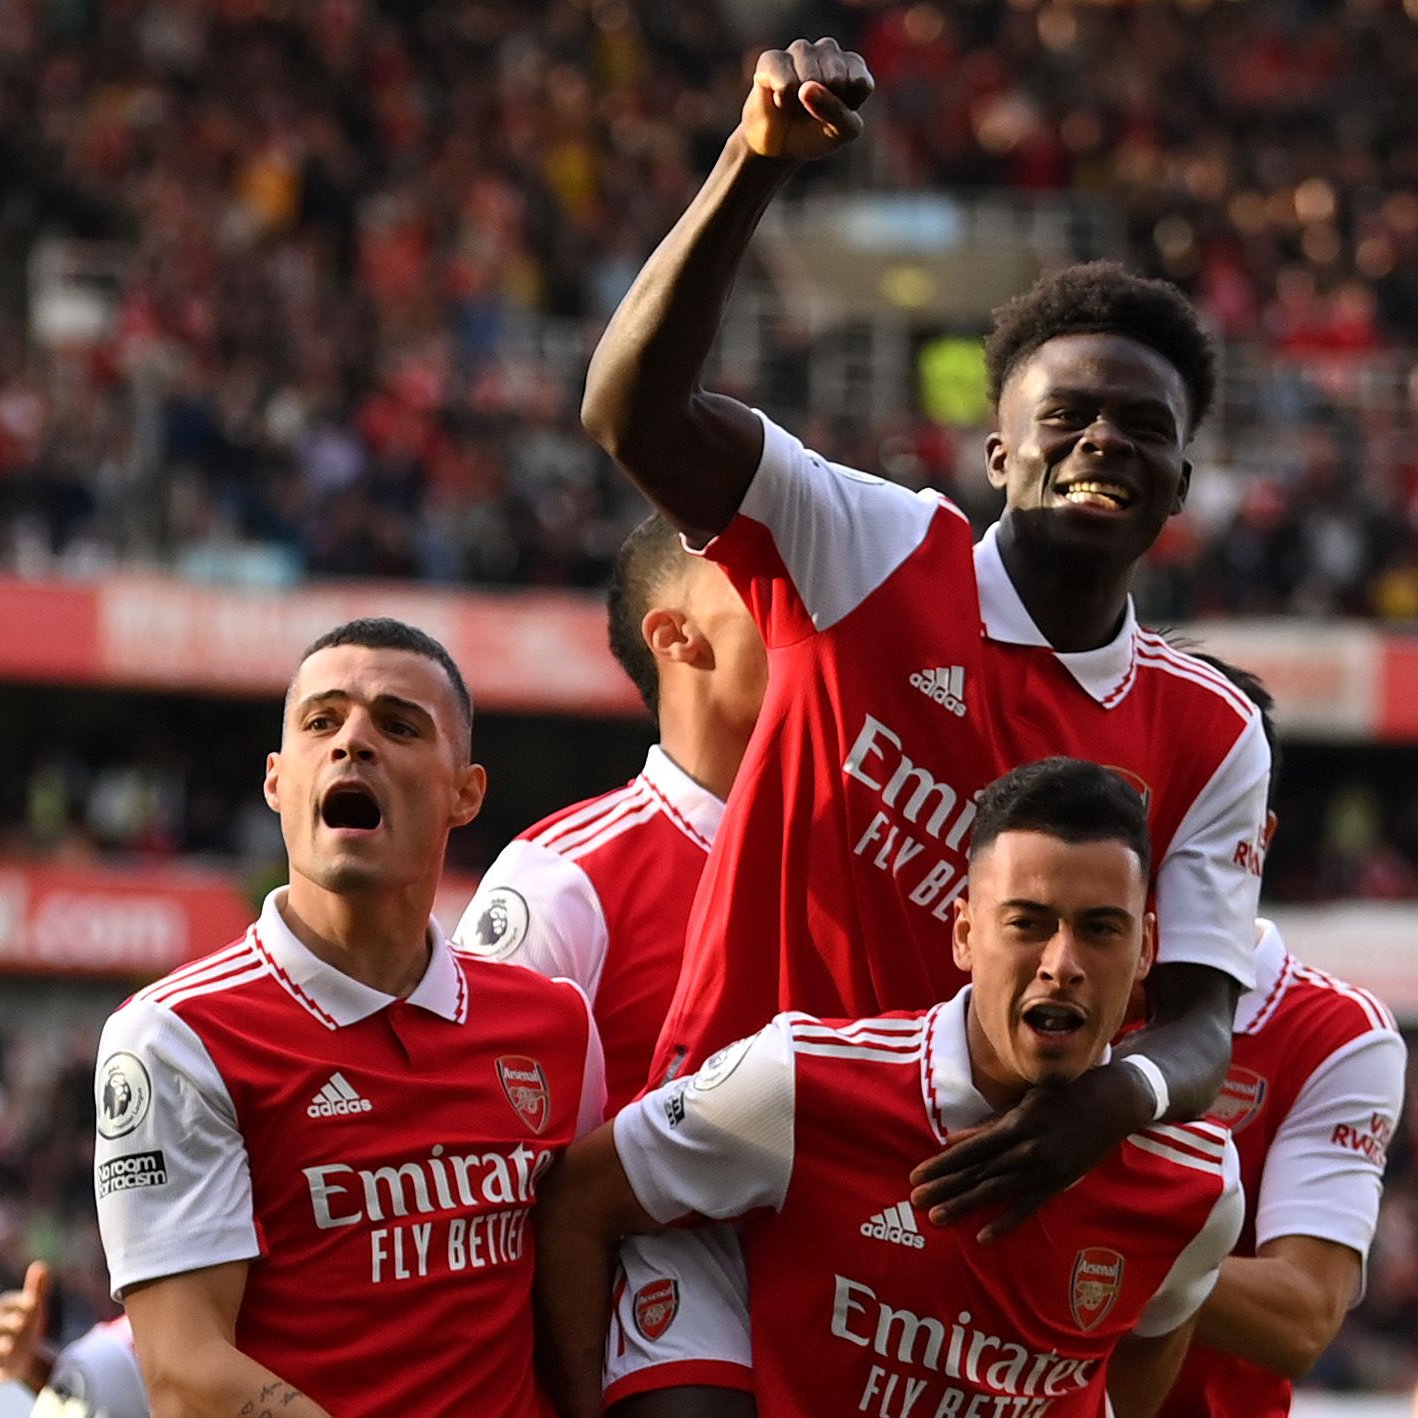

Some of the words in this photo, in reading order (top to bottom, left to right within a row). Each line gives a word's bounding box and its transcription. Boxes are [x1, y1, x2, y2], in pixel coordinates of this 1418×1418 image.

[909, 672, 967, 717] adidas
[854, 811, 925, 878] FLY
[504, 1067, 540, 1082] Arsenal
[307, 1098, 372, 1118] adidas
[111, 1155, 156, 1178] room
[111, 1170, 165, 1191] racism
[302, 1142, 552, 1229] Emirate
[860, 1221, 926, 1249] adidas
[371, 1222, 432, 1283] FLY
[1079, 1260, 1117, 1276] Arsenal
